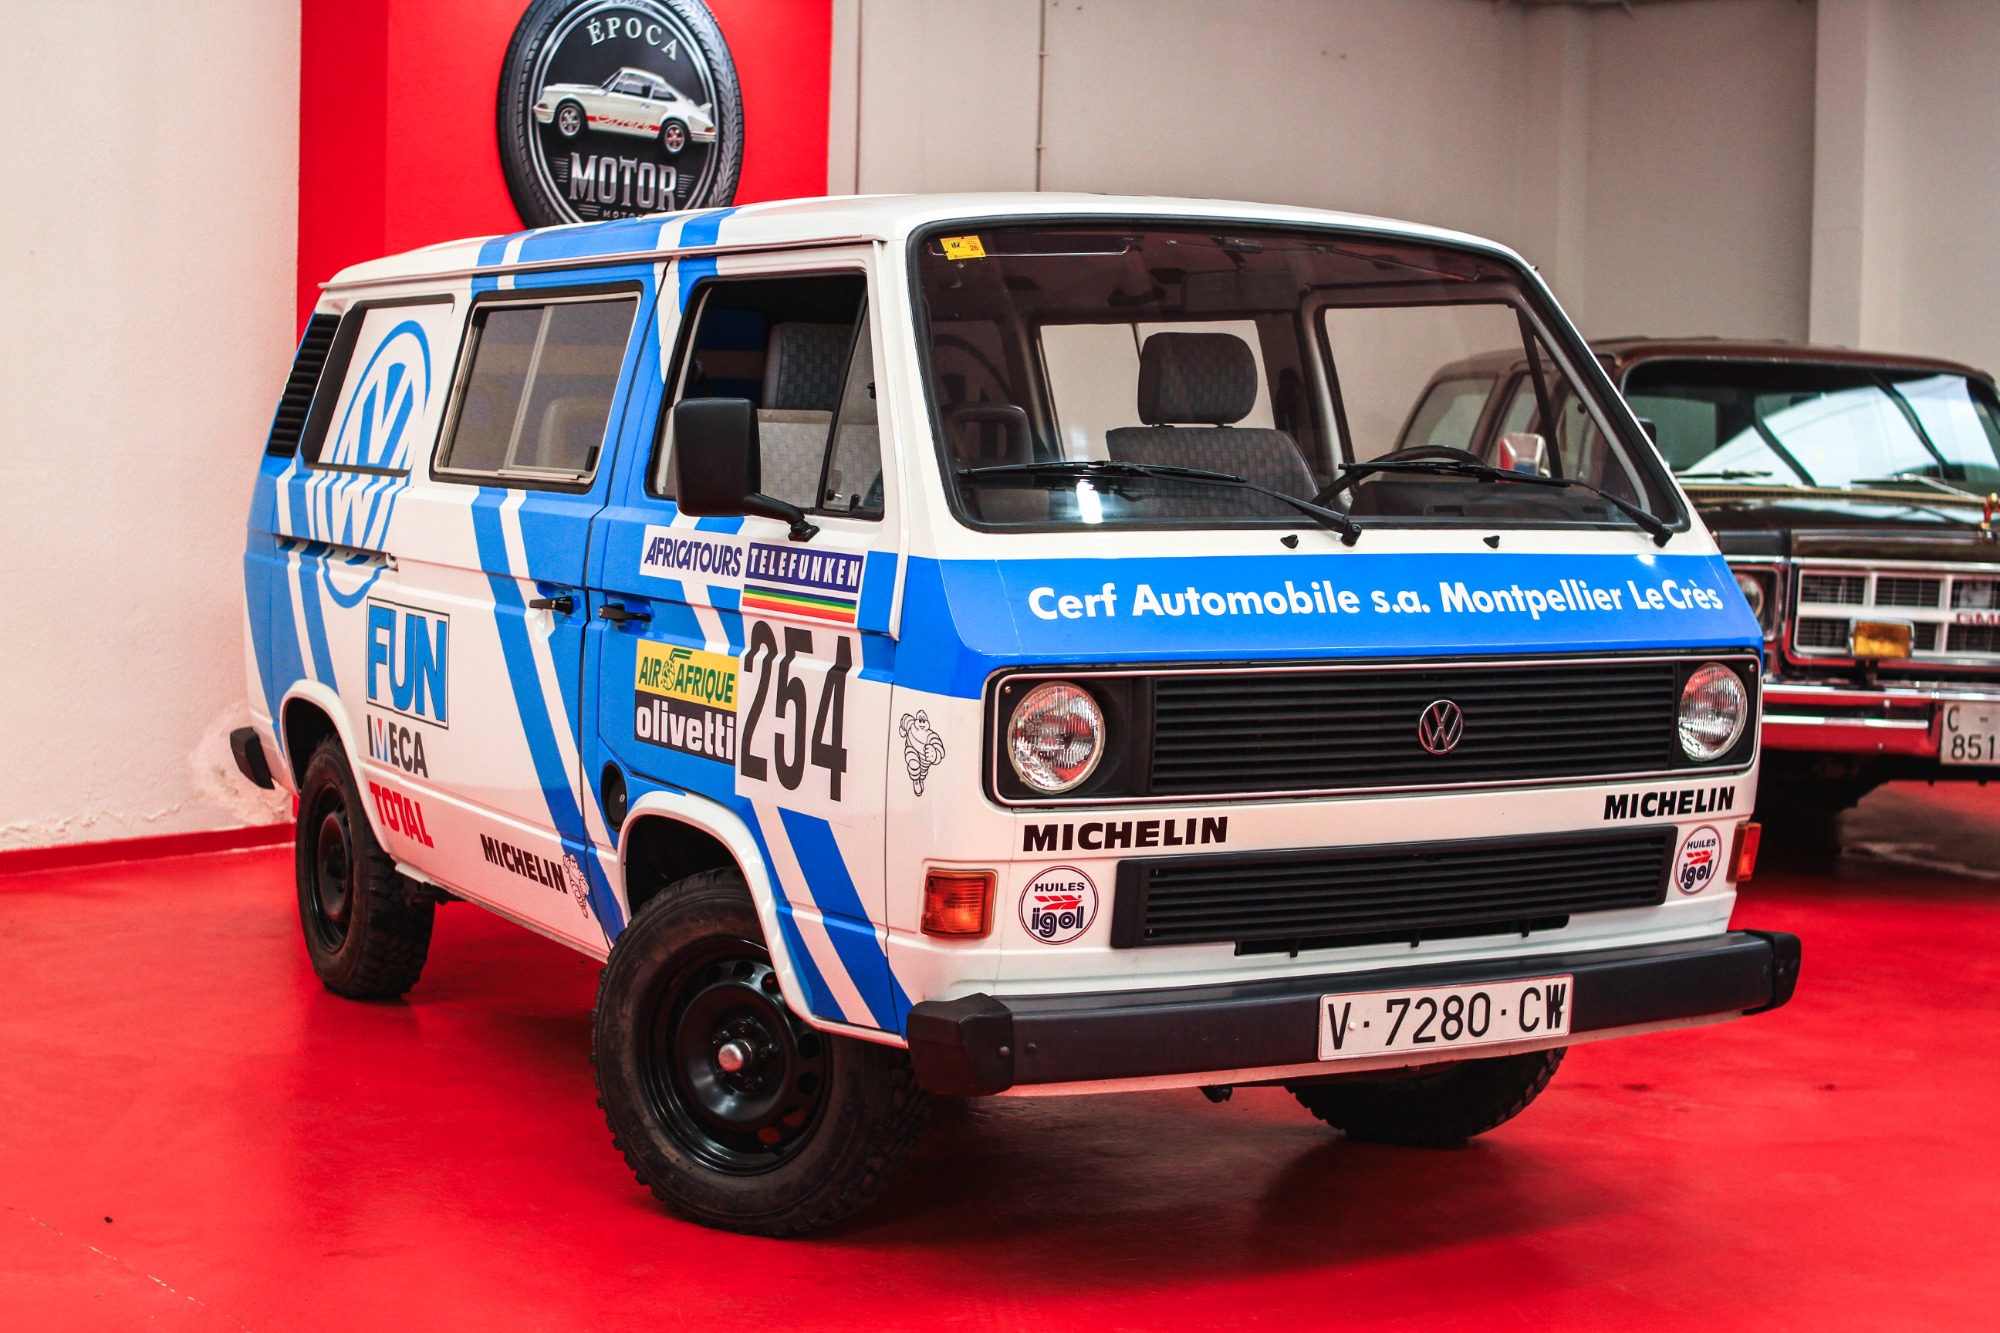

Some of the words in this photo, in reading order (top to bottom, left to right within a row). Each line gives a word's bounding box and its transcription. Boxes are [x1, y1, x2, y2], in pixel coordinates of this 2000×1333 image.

[586, 17, 678, 61] ÉPOCA
[568, 152, 678, 212] MOTOR
[644, 537, 742, 577] AFRICATOURS
[750, 549, 861, 587] TELEFUNKEN
[1028, 582, 1117, 620] Cerf
[1132, 580, 1361, 616] Automobile
[1370, 589, 1431, 613] s.a.
[1439, 578, 1622, 620] Montpellier
[368, 603, 447, 722] FUN
[638, 656, 661, 687] AIR
[673, 662, 736, 704] AFRIQUE
[636, 700, 735, 760] olivetti
[740, 620, 853, 802] 254
[369, 781, 434, 849] TOTAL
[1603, 785, 1736, 821] MICHELIN
[1023, 816, 1228, 852] MICHELIN
[1686, 838, 1716, 850] HUILES
[480, 833, 568, 894] MICHELIN
[1680, 859, 1714, 890] igol
[1034, 882, 1085, 893] HUILES
